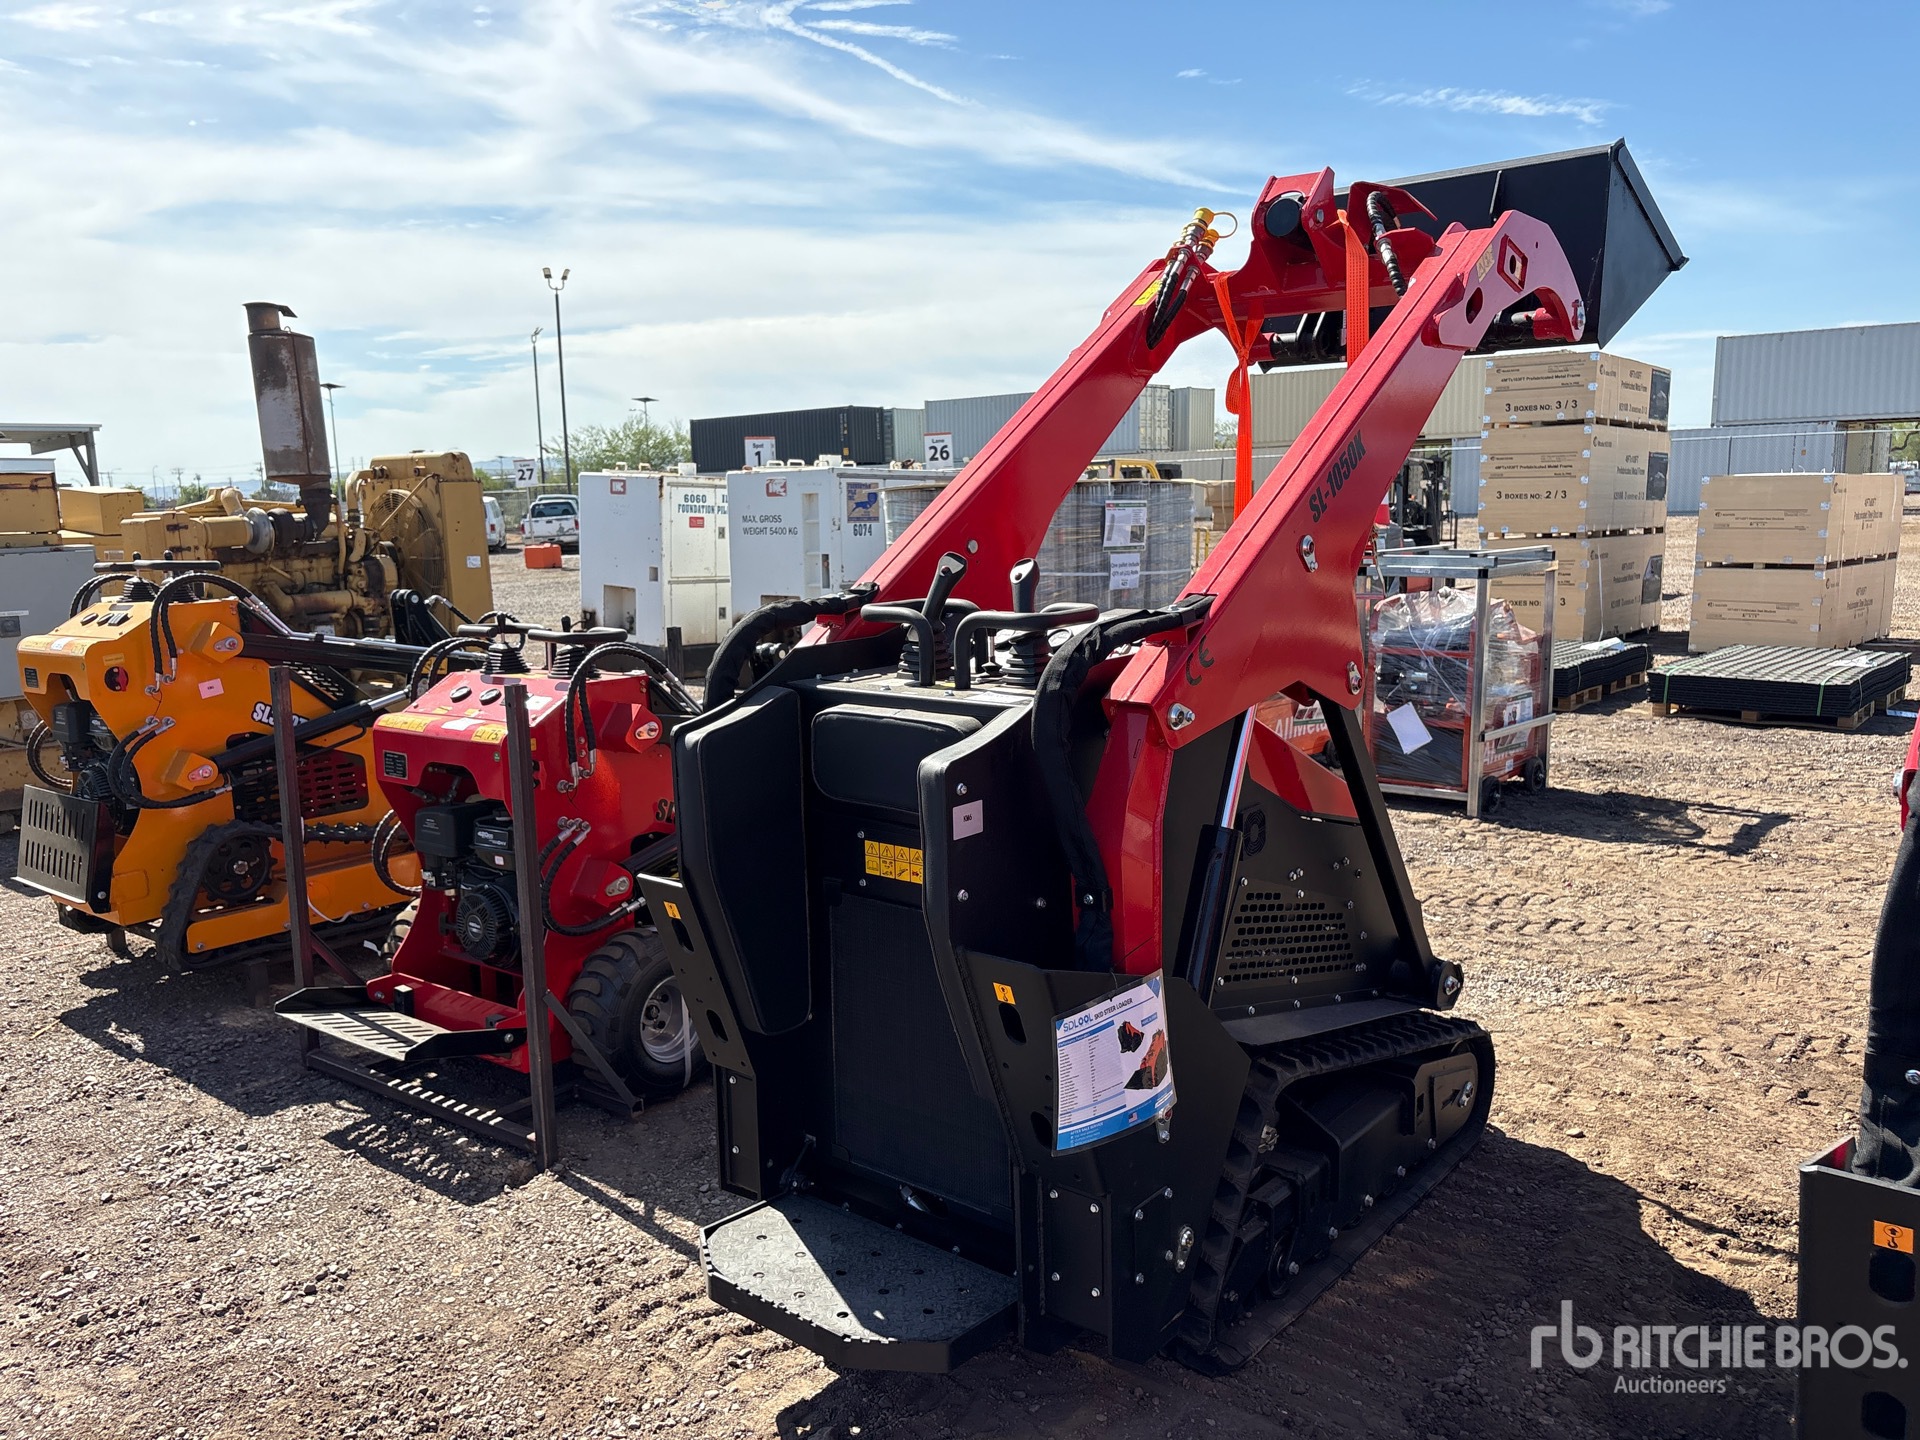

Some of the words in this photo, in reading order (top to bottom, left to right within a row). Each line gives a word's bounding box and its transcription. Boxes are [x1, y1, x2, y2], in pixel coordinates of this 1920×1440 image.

[1505, 403, 1511, 412] 3
[1556, 400, 1562, 409] 3
[1564, 400, 1569, 409] /
[1571, 399, 1578, 408] 3
[755, 450, 761, 467] 1
[929, 445, 949, 461] 26
[517, 468, 534, 480] 27
[1309, 429, 1366, 523] SL-1050K
[684, 494, 706, 503] 6060
[1496, 490, 1502, 499] 3
[1545, 490, 1552, 499] 2
[1554, 490, 1558, 499] /
[1561, 490, 1567, 499] 3
[678, 504, 715, 514] FOUNDATION
[759, 515, 782, 523] GROSS
[743, 527, 768, 535] WEIGHT
[769, 527, 787, 535] 5400
[788, 527, 798, 535] KG
[853, 524, 872, 536] 6074
[1560, 597, 1566, 606] 3
[655, 798, 675, 823] SL
[1063, 1013, 1094, 1032] SDLOOL
[1104, 1004, 1116, 1016] STEER
[1116, 997, 1133, 1010] LOADER
